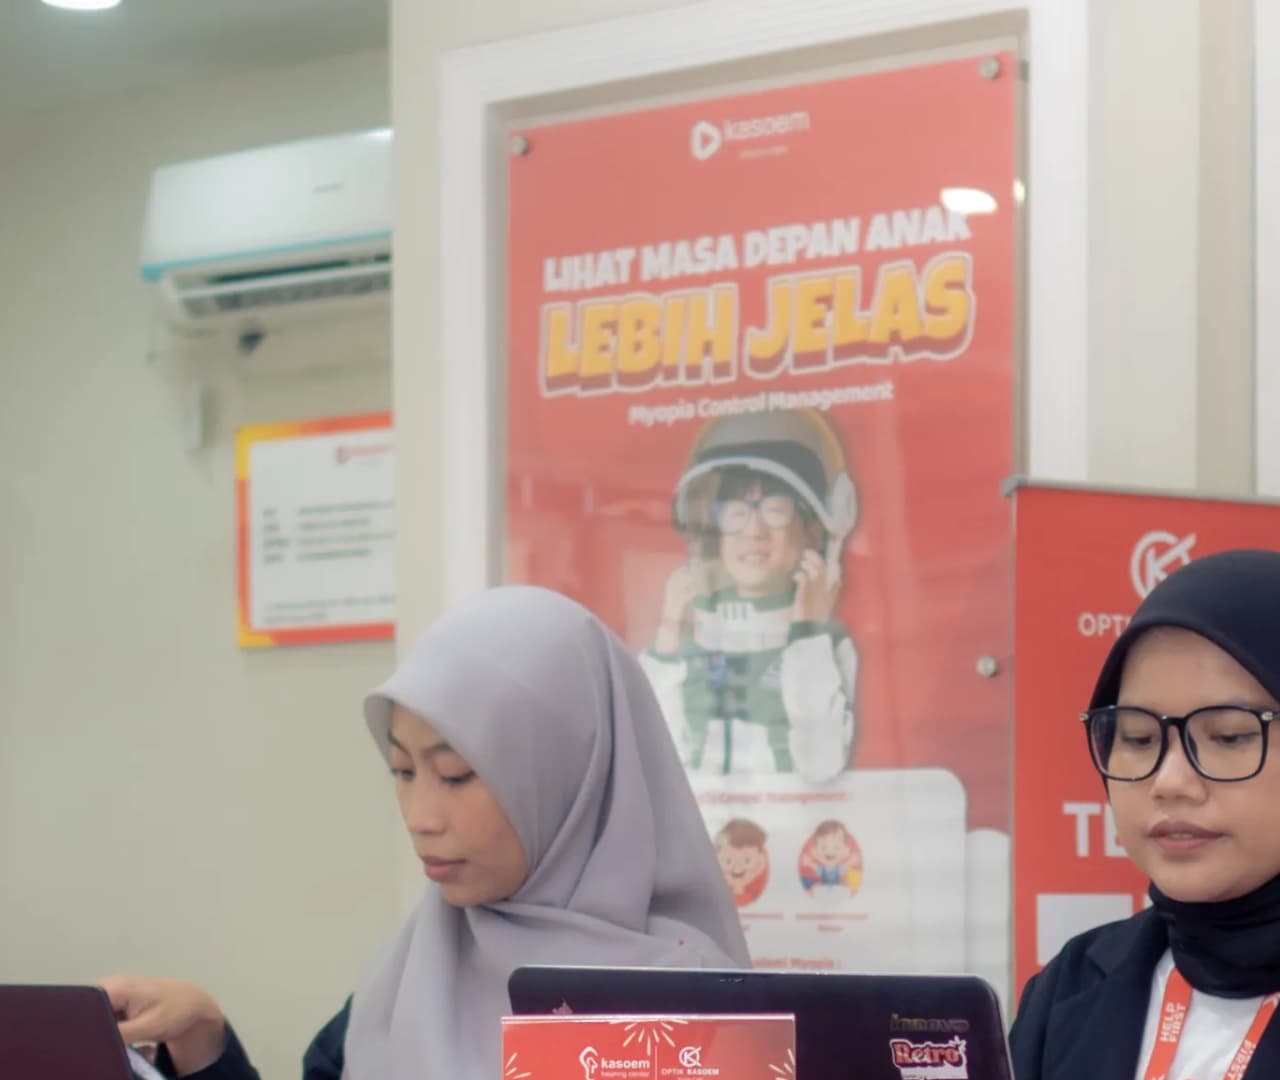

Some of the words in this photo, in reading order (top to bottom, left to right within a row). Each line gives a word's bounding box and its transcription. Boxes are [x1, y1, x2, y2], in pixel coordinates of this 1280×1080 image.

[544, 248, 637, 292] LIHAT
[640, 236, 738, 282] MASA
[744, 217, 861, 270] DEPAN
[866, 205, 972, 250] ANAK
[541, 283, 738, 397] LEBIH
[743, 252, 976, 378] JELAS
[629, 399, 695, 426] Myopia
[697, 393, 766, 418] Control
[768, 381, 894, 413] Management
[1077, 611, 1131, 637] OPT
[601, 1057, 650, 1069] kasoem
[893, 1042, 963, 1067] Retro
[661, 1068, 683, 1076] OPTIK
[686, 1068, 720, 1076] KASOEM
